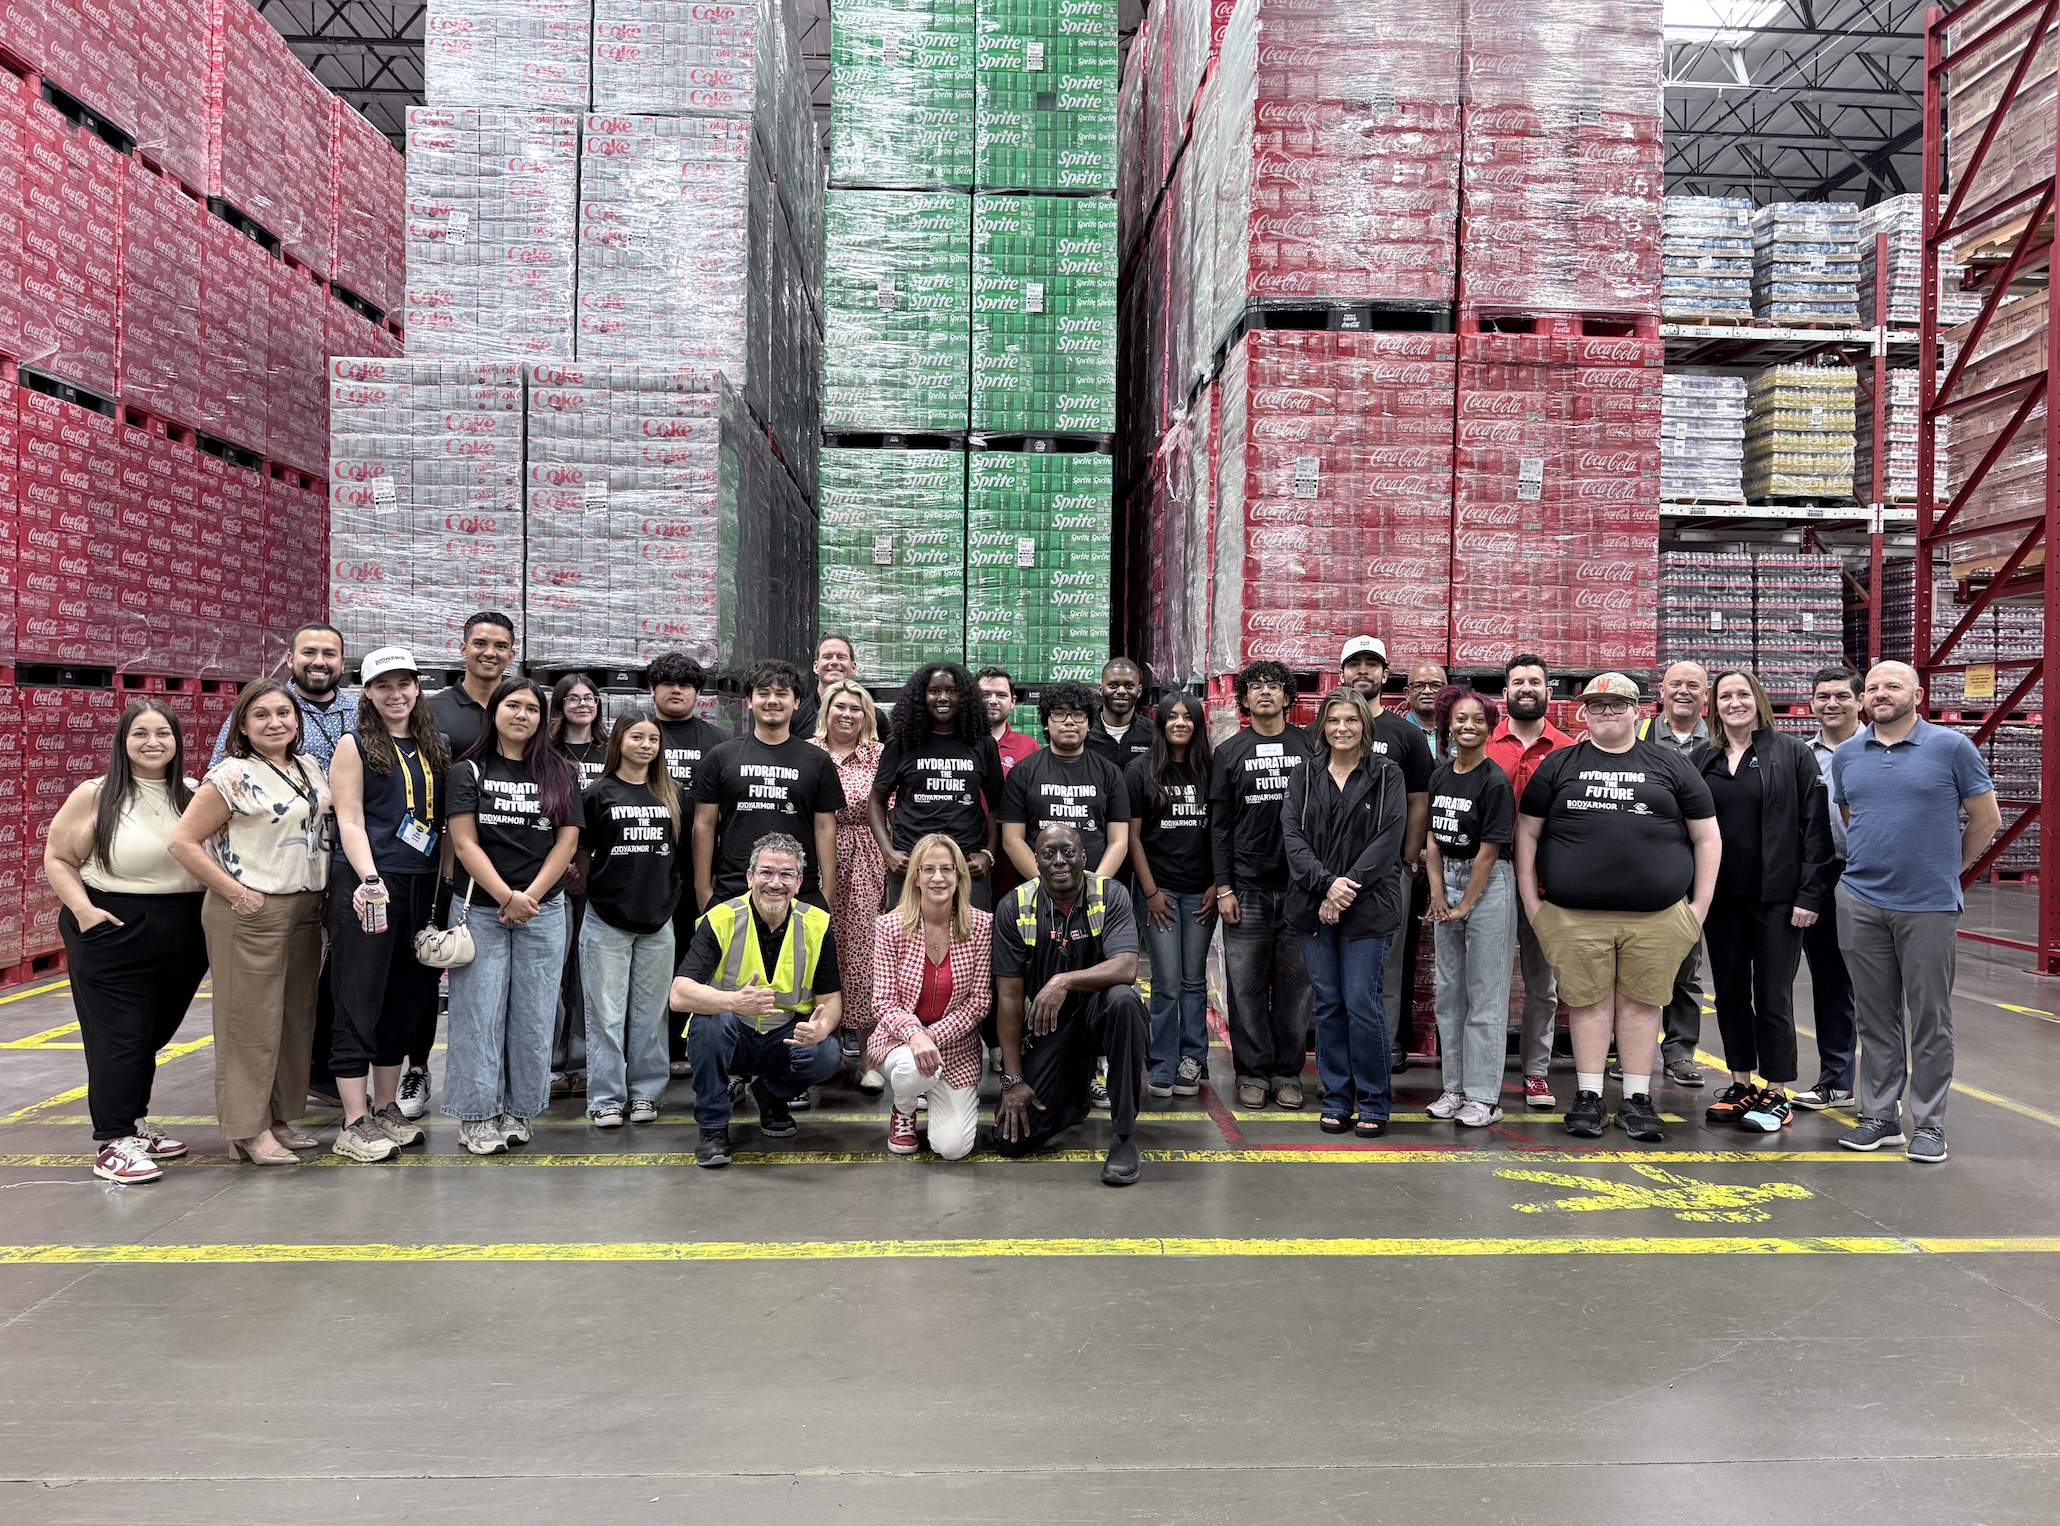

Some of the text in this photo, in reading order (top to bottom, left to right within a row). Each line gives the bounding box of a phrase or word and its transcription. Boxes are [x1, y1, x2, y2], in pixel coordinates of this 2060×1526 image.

[693, 5, 734, 23] Coke
[1059, 1, 1102, 16] Sprite
[599, 23, 641, 40] Coke
[1059, 19, 1102, 34] Sprite
[916, 34, 959, 49] Sprite
[979, 35, 1021, 51] Sprite
[598, 45, 641, 61] Coke
[915, 52, 959, 68] Sprite
[978, 53, 1021, 69] Sprite
[691, 69, 733, 86] Coke
[1059, 75, 1102, 90] Sprite
[691, 91, 732, 108] Coke
[1059, 94, 1102, 110] Sprite
[588, 115, 632, 134] Coke
[914, 108, 958, 126] Sprite
[588, 138, 631, 155] Coke
[1059, 151, 1102, 168] Sprite
[1059, 170, 1102, 186] Sprite
[978, 197, 1020, 213] Sprite
[911, 214, 954, 230] Sprite
[977, 216, 1019, 232] Sprite
[1059, 239, 1102, 255] Sprite
[1059, 258, 1102, 274] Sprite
[975, 275, 1019, 292] Sprite
[909, 293, 954, 309] Sprite
[975, 295, 1018, 311] Sprite
[1057, 317, 1101, 333] Sprite
[1057, 336, 1101, 352] Sprite
[908, 352, 953, 368] Sprite
[976, 354, 1018, 370] Sprite
[335, 360, 385, 380] Coke
[533, 365, 583, 385] Coke
[908, 372, 953, 388] Sprite
[975, 373, 1018, 389] Sprite
[533, 390, 583, 410] Coke
[1057, 395, 1100, 410] Sprite
[446, 413, 496, 433] Coke
[643, 418, 692, 438] Coke
[1056, 414, 1100, 430] Sprite
[446, 438, 496, 458] Coke
[643, 443, 692, 464] Coke
[1093, 458, 1112, 466] Sprite
[334, 460, 385, 481] Coke
[532, 466, 582, 487] Coke
[971, 474, 1014, 490] Sprite
[533, 490, 582, 510] Coke
[1052, 494, 1096, 510] Sprite
[446, 514, 496, 533] Coke
[642, 518, 691, 538] Coke
[1052, 513, 1096, 529] Sprite
[970, 531, 1013, 547] Sprite
[904, 549, 948, 565] Sprite
[969, 550, 1013, 566] Sprite
[1071, 553, 1090, 562] Sprite
[335, 561, 385, 581] Coke
[532, 565, 581, 584] Coke
[1051, 571, 1095, 587] Sprite
[1051, 590, 1094, 606] Sprite
[904, 607, 948, 623] Sprite
[969, 608, 1012, 624] Sprite
[904, 626, 947, 642] Sprite
[969, 627, 1012, 642] Sprite
[1050, 648, 1094, 664] Sprite
[1050, 666, 1094, 682] Sprite
[1597, 678, 1610, 692] W
[665, 749, 701, 760] RATING
[667, 766, 691, 778] TURE
[740, 765, 799, 780] HYDRATING
[917, 758, 974, 771] HYDRATING
[940, 770, 952, 778] THE
[1269, 769, 1280, 777] THE
[1579, 770, 1645, 783] HYDRATING
[483, 779, 540, 794] HYDRATI
[764, 777, 776, 786] THE
[926, 778, 965, 791] FUTURE
[1256, 776, 1290, 790] FUTUR
[749, 784, 788, 799] FUTURE
[1041, 784, 1096, 797] HYDRATING
[1586, 786, 1634, 800] FUTURE
[494, 797, 541, 813] FUTURE
[1063, 797, 1074, 805] THE
[1567, 800, 1617, 810] BODYARMOR
[611, 806, 671, 820] HYDRATIN
[1050, 804, 1088, 817] FUTURE
[1445, 809, 1456, 818] THE
[479, 813, 525, 826] BODYARMOR
[638, 818, 650, 826] THE
[623, 827, 663, 841] FUTURE
